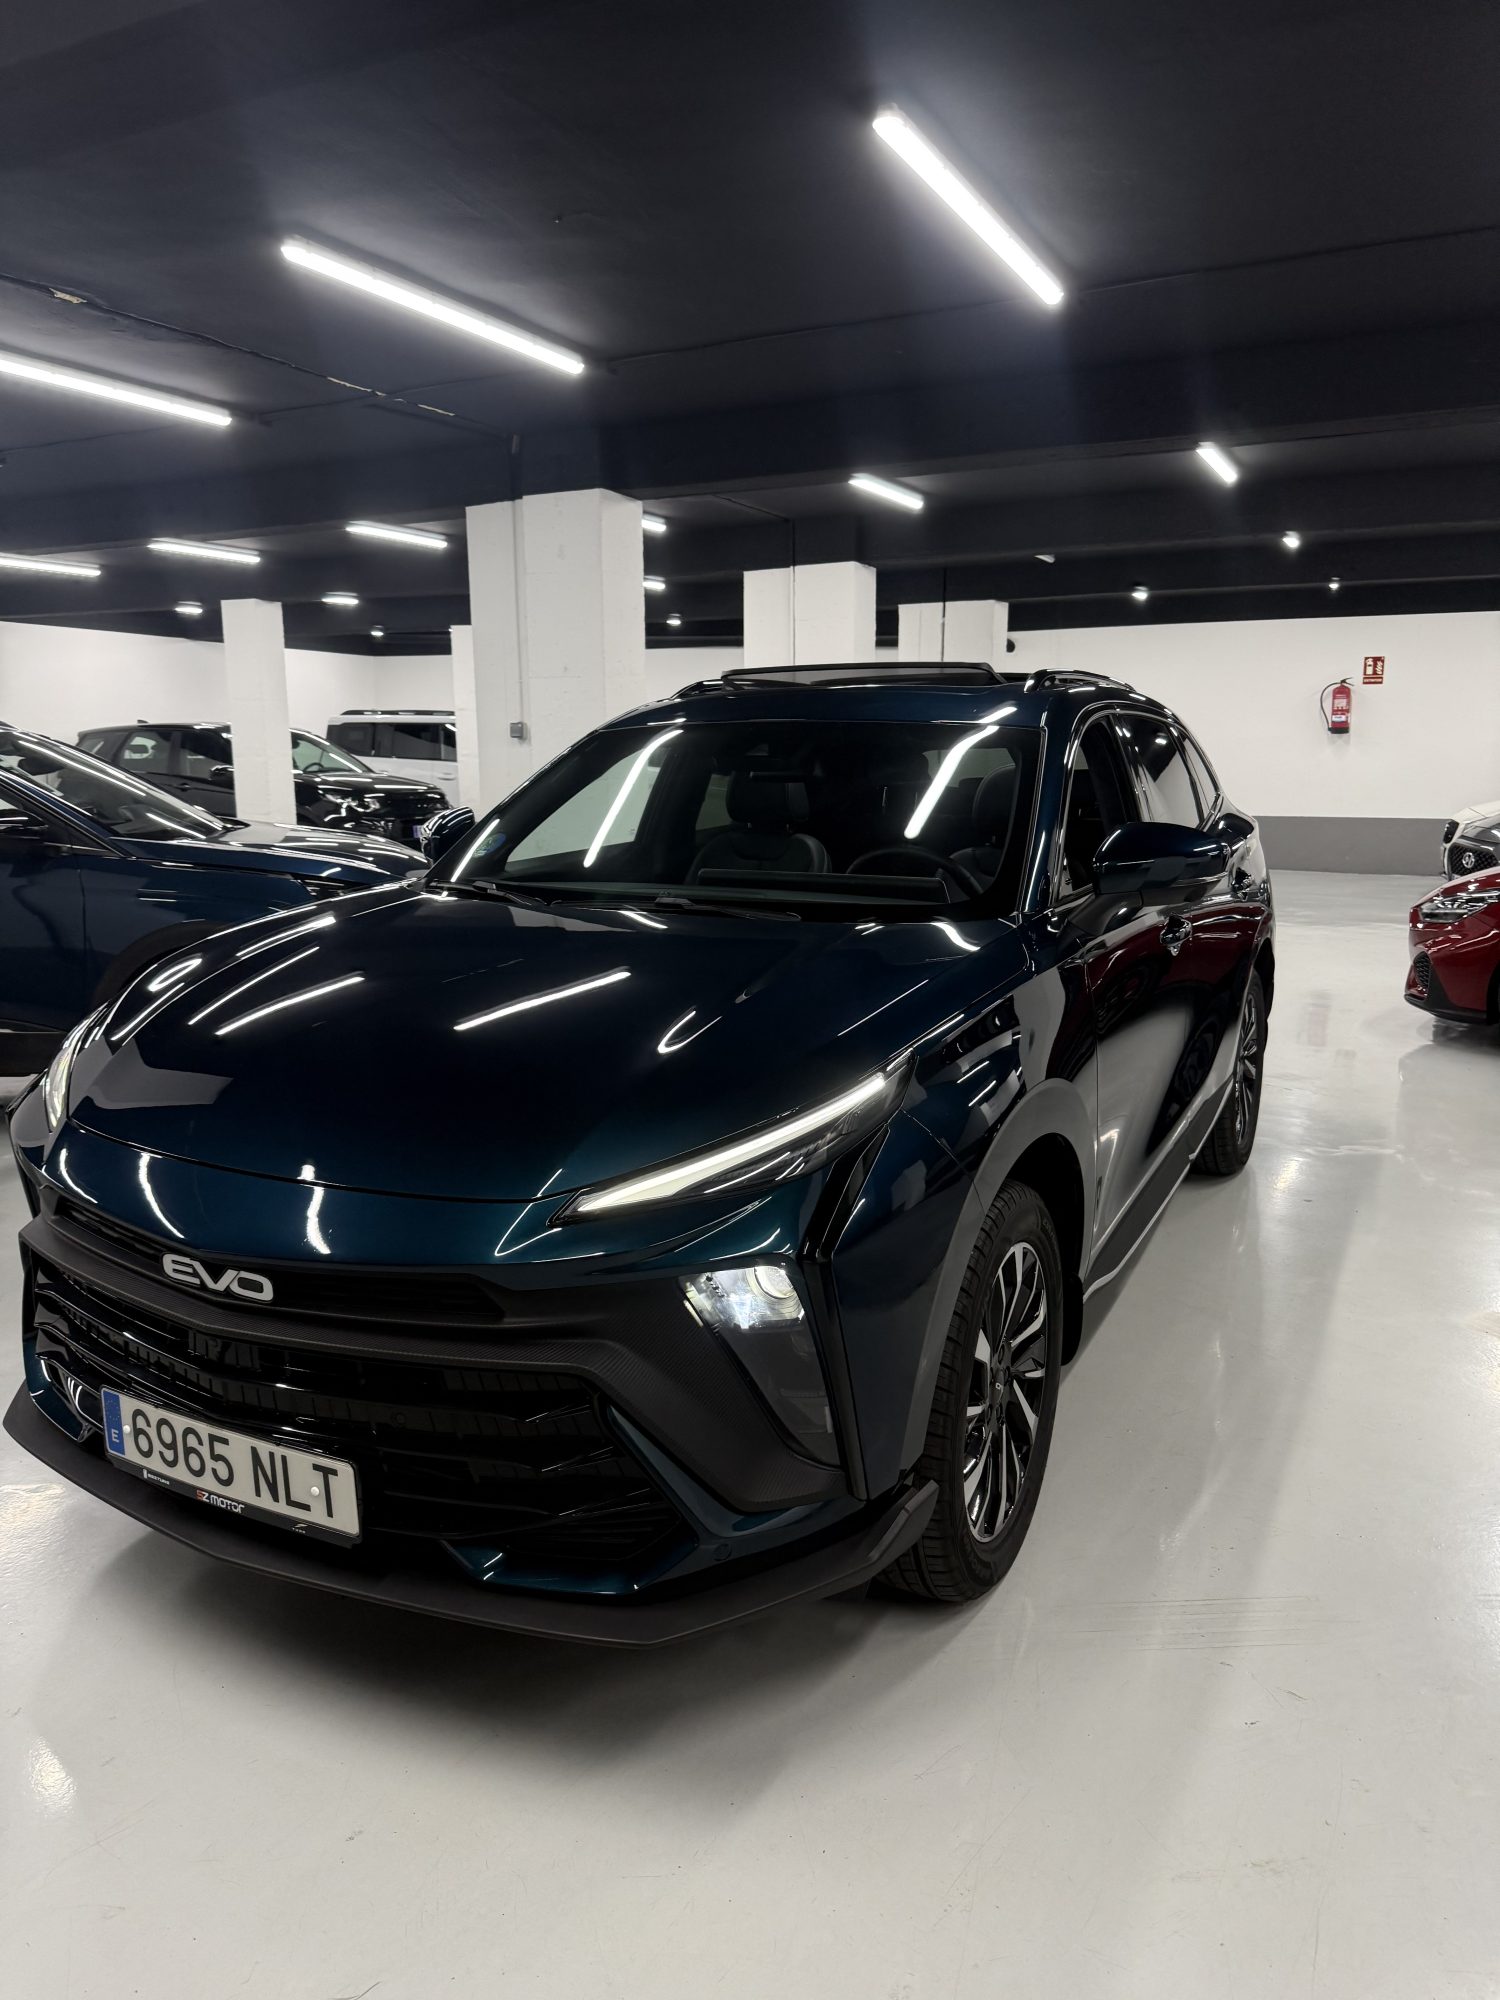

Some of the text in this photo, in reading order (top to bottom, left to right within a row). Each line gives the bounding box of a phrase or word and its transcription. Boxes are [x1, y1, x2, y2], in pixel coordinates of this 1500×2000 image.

[162, 1253, 274, 1301] EVO
[111, 1430, 119, 1443] E
[131, 1408, 338, 1518] 6965 NLT
